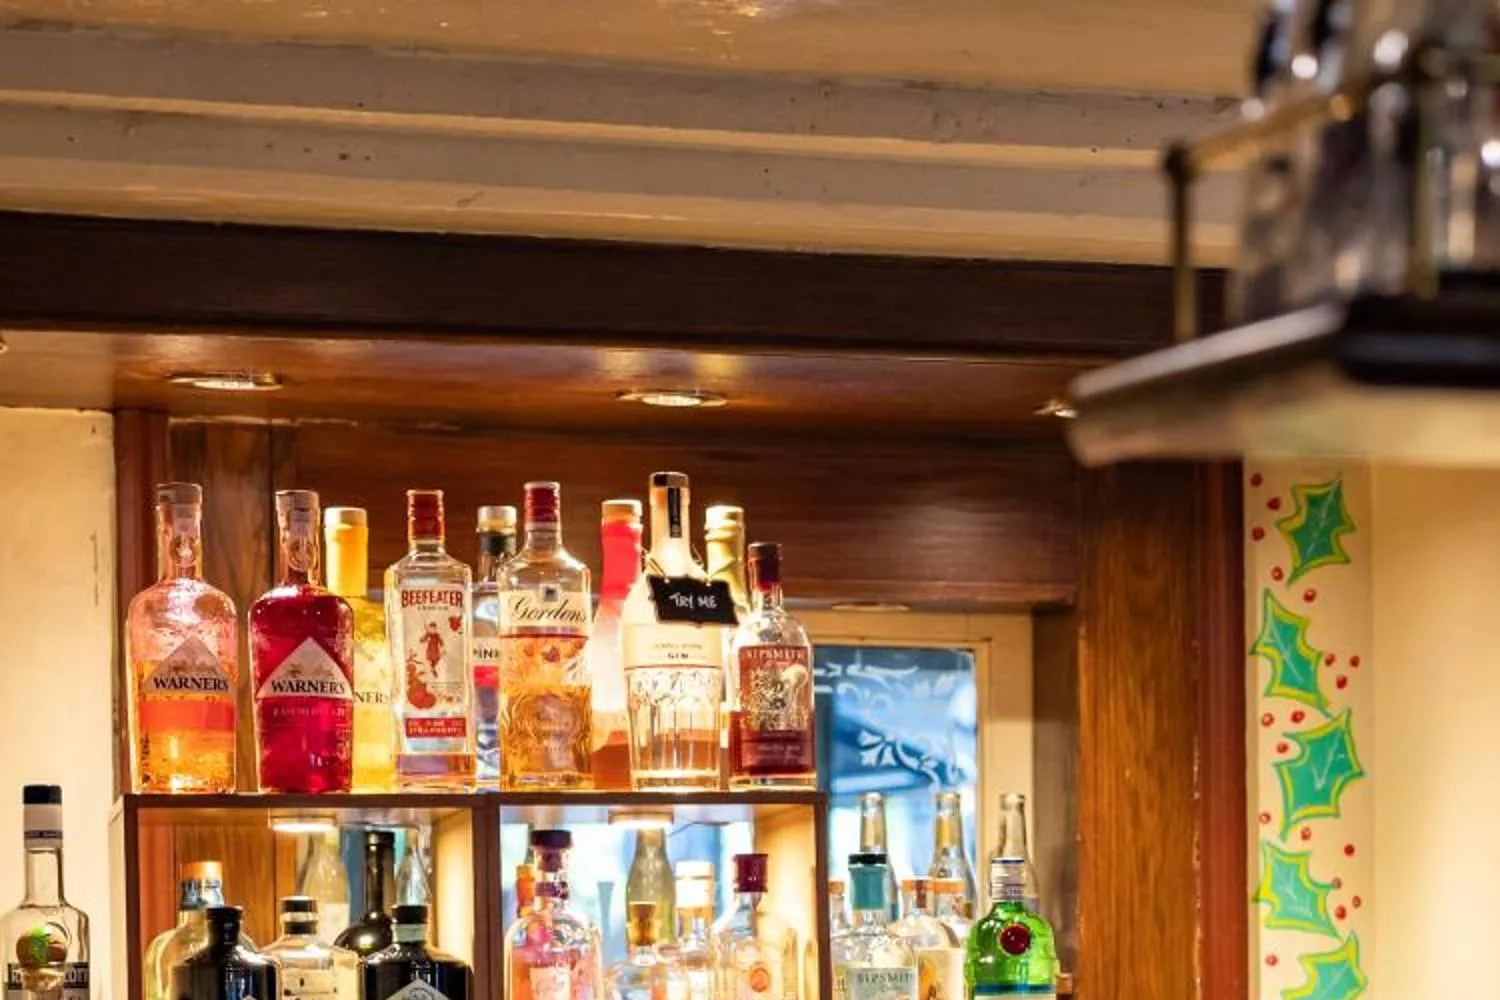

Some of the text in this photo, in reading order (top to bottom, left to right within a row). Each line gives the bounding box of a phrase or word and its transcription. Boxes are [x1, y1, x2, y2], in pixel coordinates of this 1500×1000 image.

[401, 589, 463, 608] BEEFEATER
[669, 592, 718, 609] TRY ME
[667, 651, 689, 660] GIN
